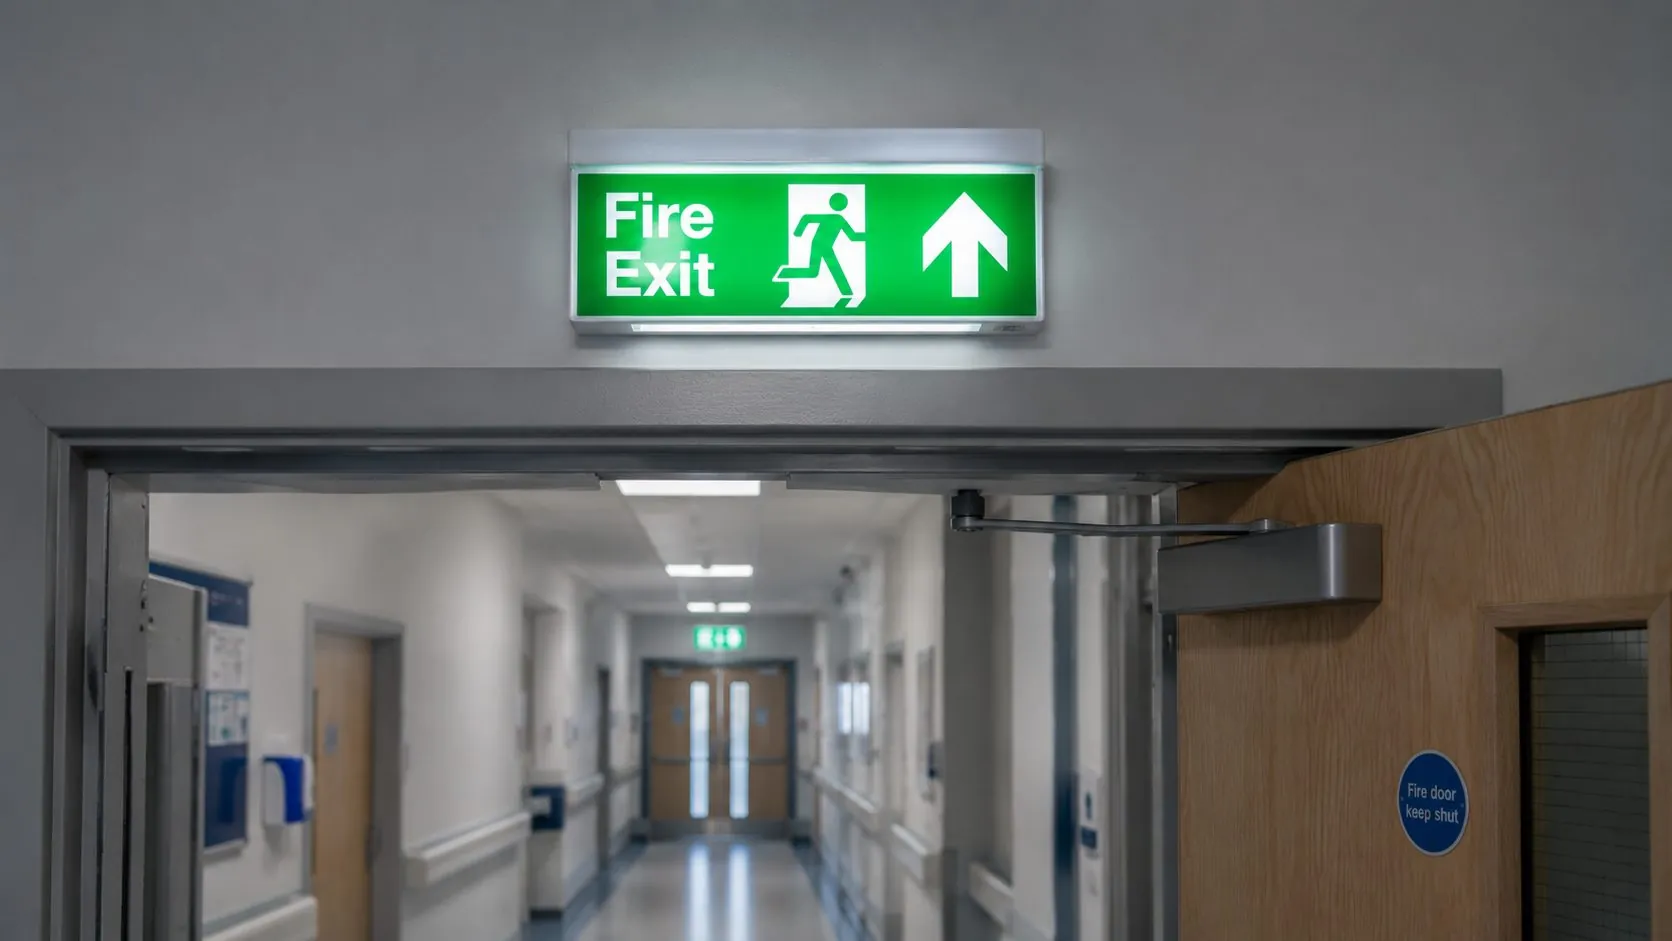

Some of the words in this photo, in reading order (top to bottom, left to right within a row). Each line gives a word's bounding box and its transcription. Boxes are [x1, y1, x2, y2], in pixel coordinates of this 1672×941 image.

[605, 192, 714, 239] Fire
[605, 251, 715, 297] Exit
[1407, 783, 1428, 799] Fire
[1430, 785, 1457, 801] door
[1406, 804, 1431, 823] keep
[1434, 808, 1459, 824] shut
